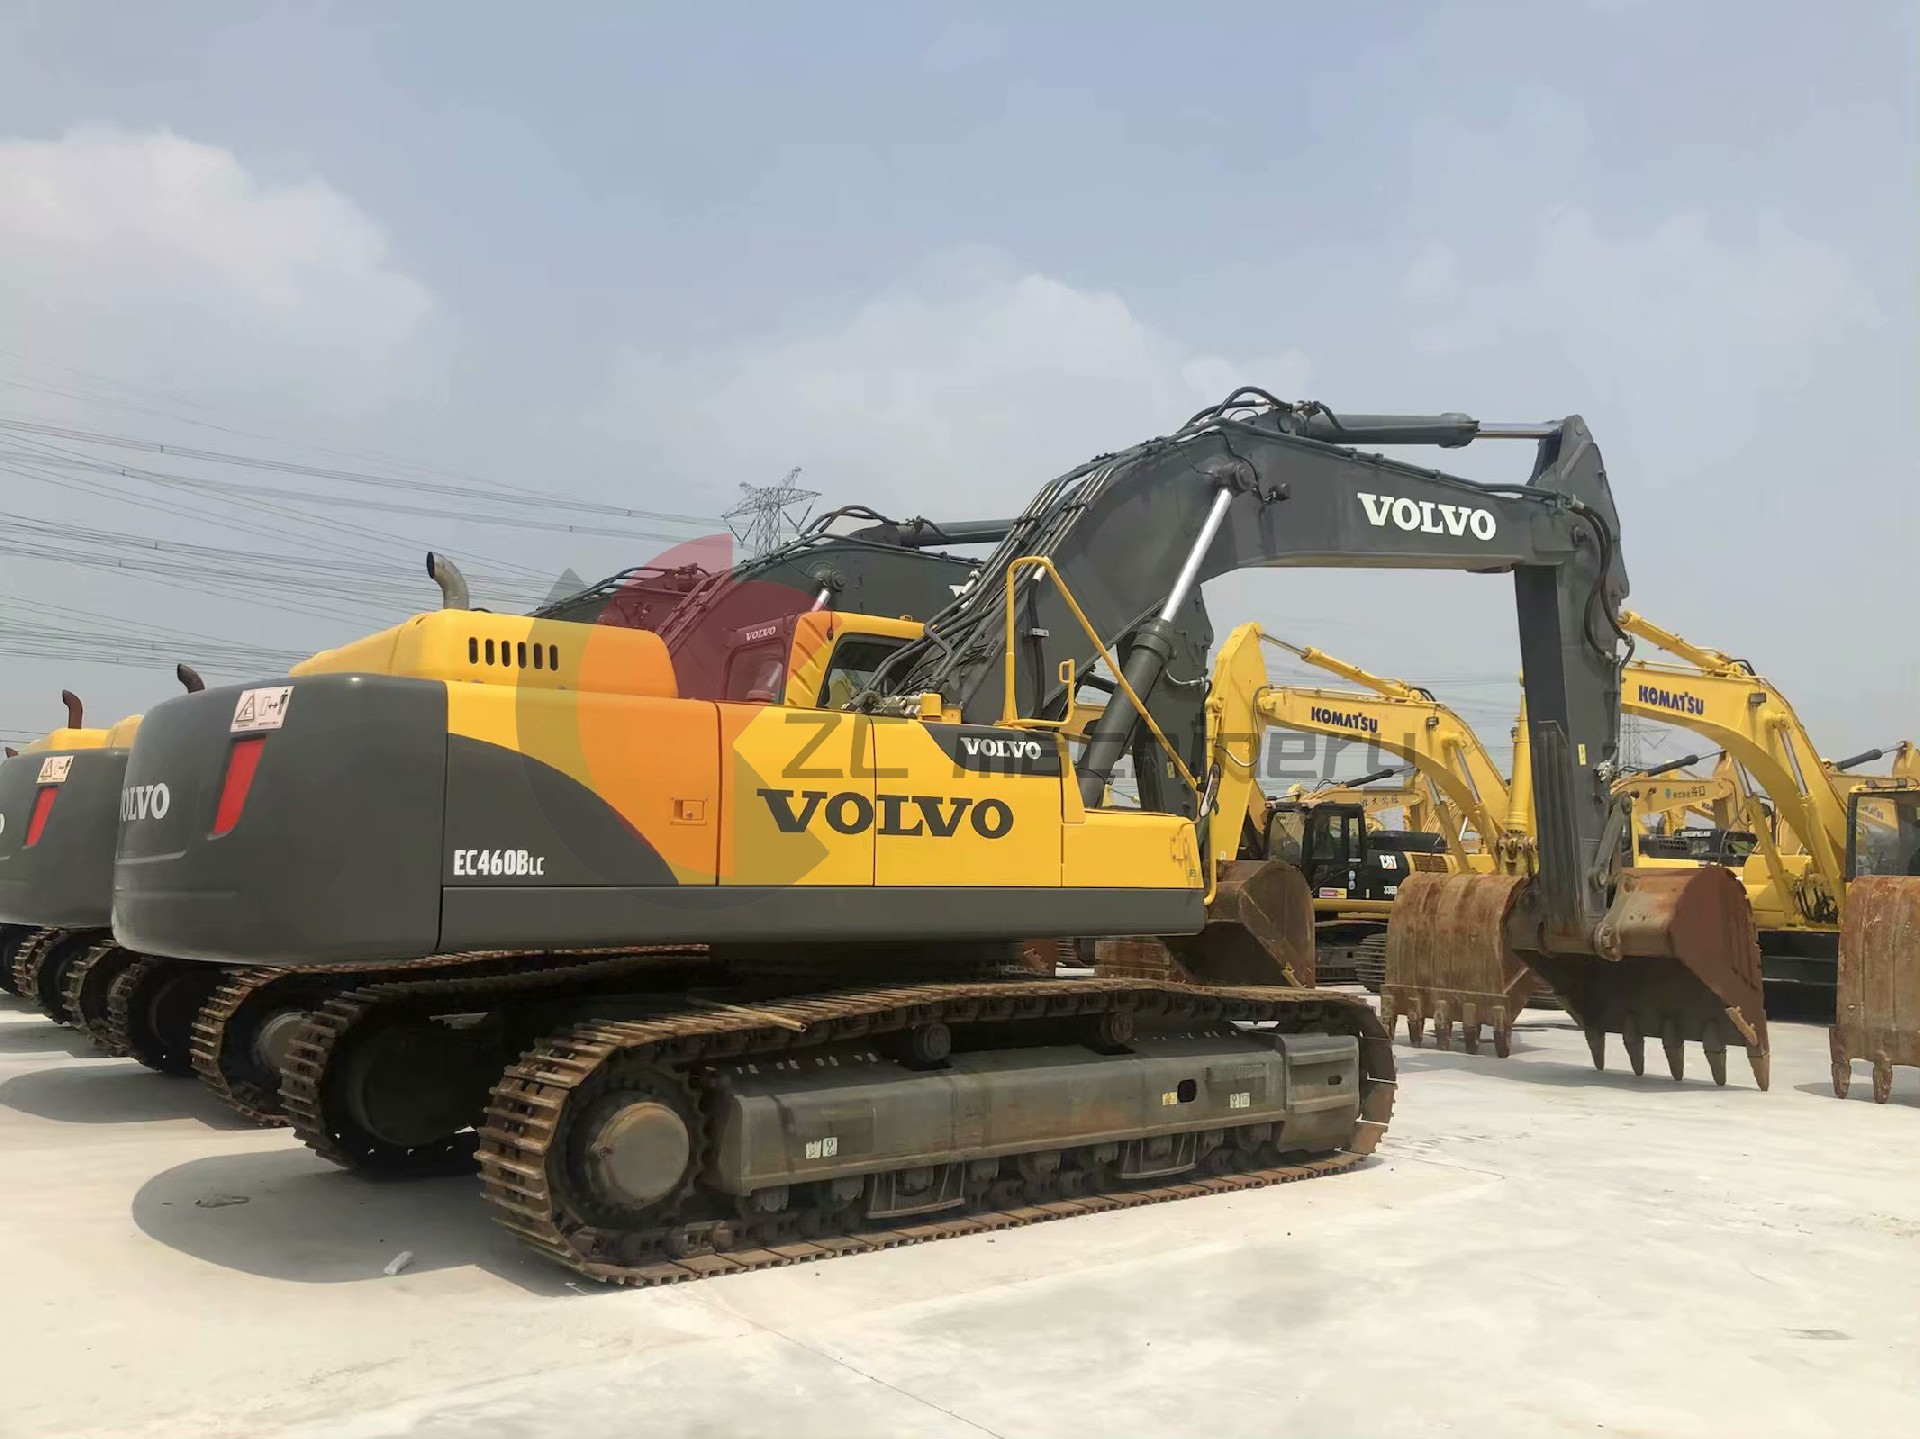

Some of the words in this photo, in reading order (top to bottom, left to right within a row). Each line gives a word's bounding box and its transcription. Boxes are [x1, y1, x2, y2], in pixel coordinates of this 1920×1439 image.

[1357, 492, 1497, 541] VOLVO
[745, 626, 777, 642] VOLVO
[1638, 684, 1704, 715] KOMATSU
[1311, 706, 1378, 733] KOMATSU
[960, 737, 1042, 760] VOLVO
[120, 783, 170, 822] OLVO
[757, 788, 1014, 839] VOLVO
[1379, 854, 1398, 869] CAT
